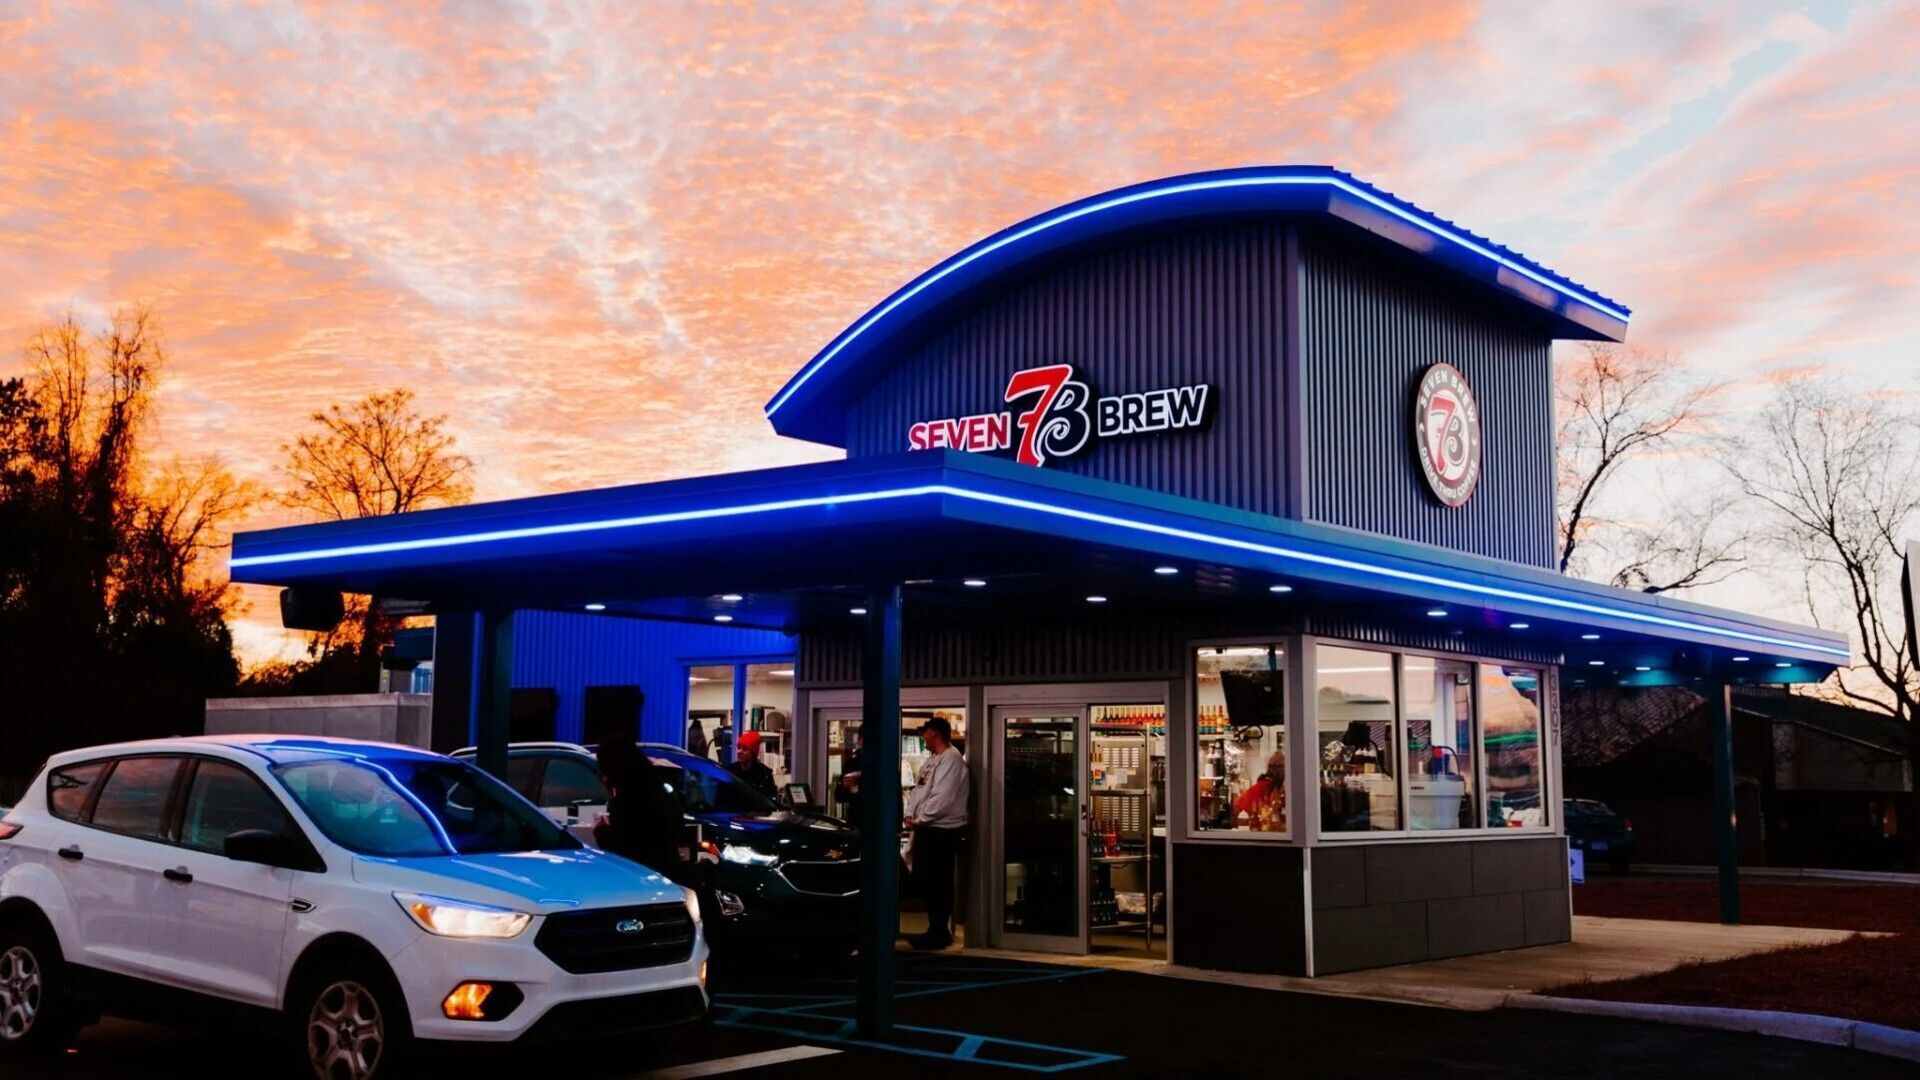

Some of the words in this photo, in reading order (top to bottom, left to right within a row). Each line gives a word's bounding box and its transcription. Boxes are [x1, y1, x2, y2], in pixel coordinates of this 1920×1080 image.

[909, 412, 1011, 452] SEVEN
[1098, 384, 1208, 437] BREW
[1420, 370, 1449, 409] SEVEN
[1450, 374, 1476, 423] BREW
